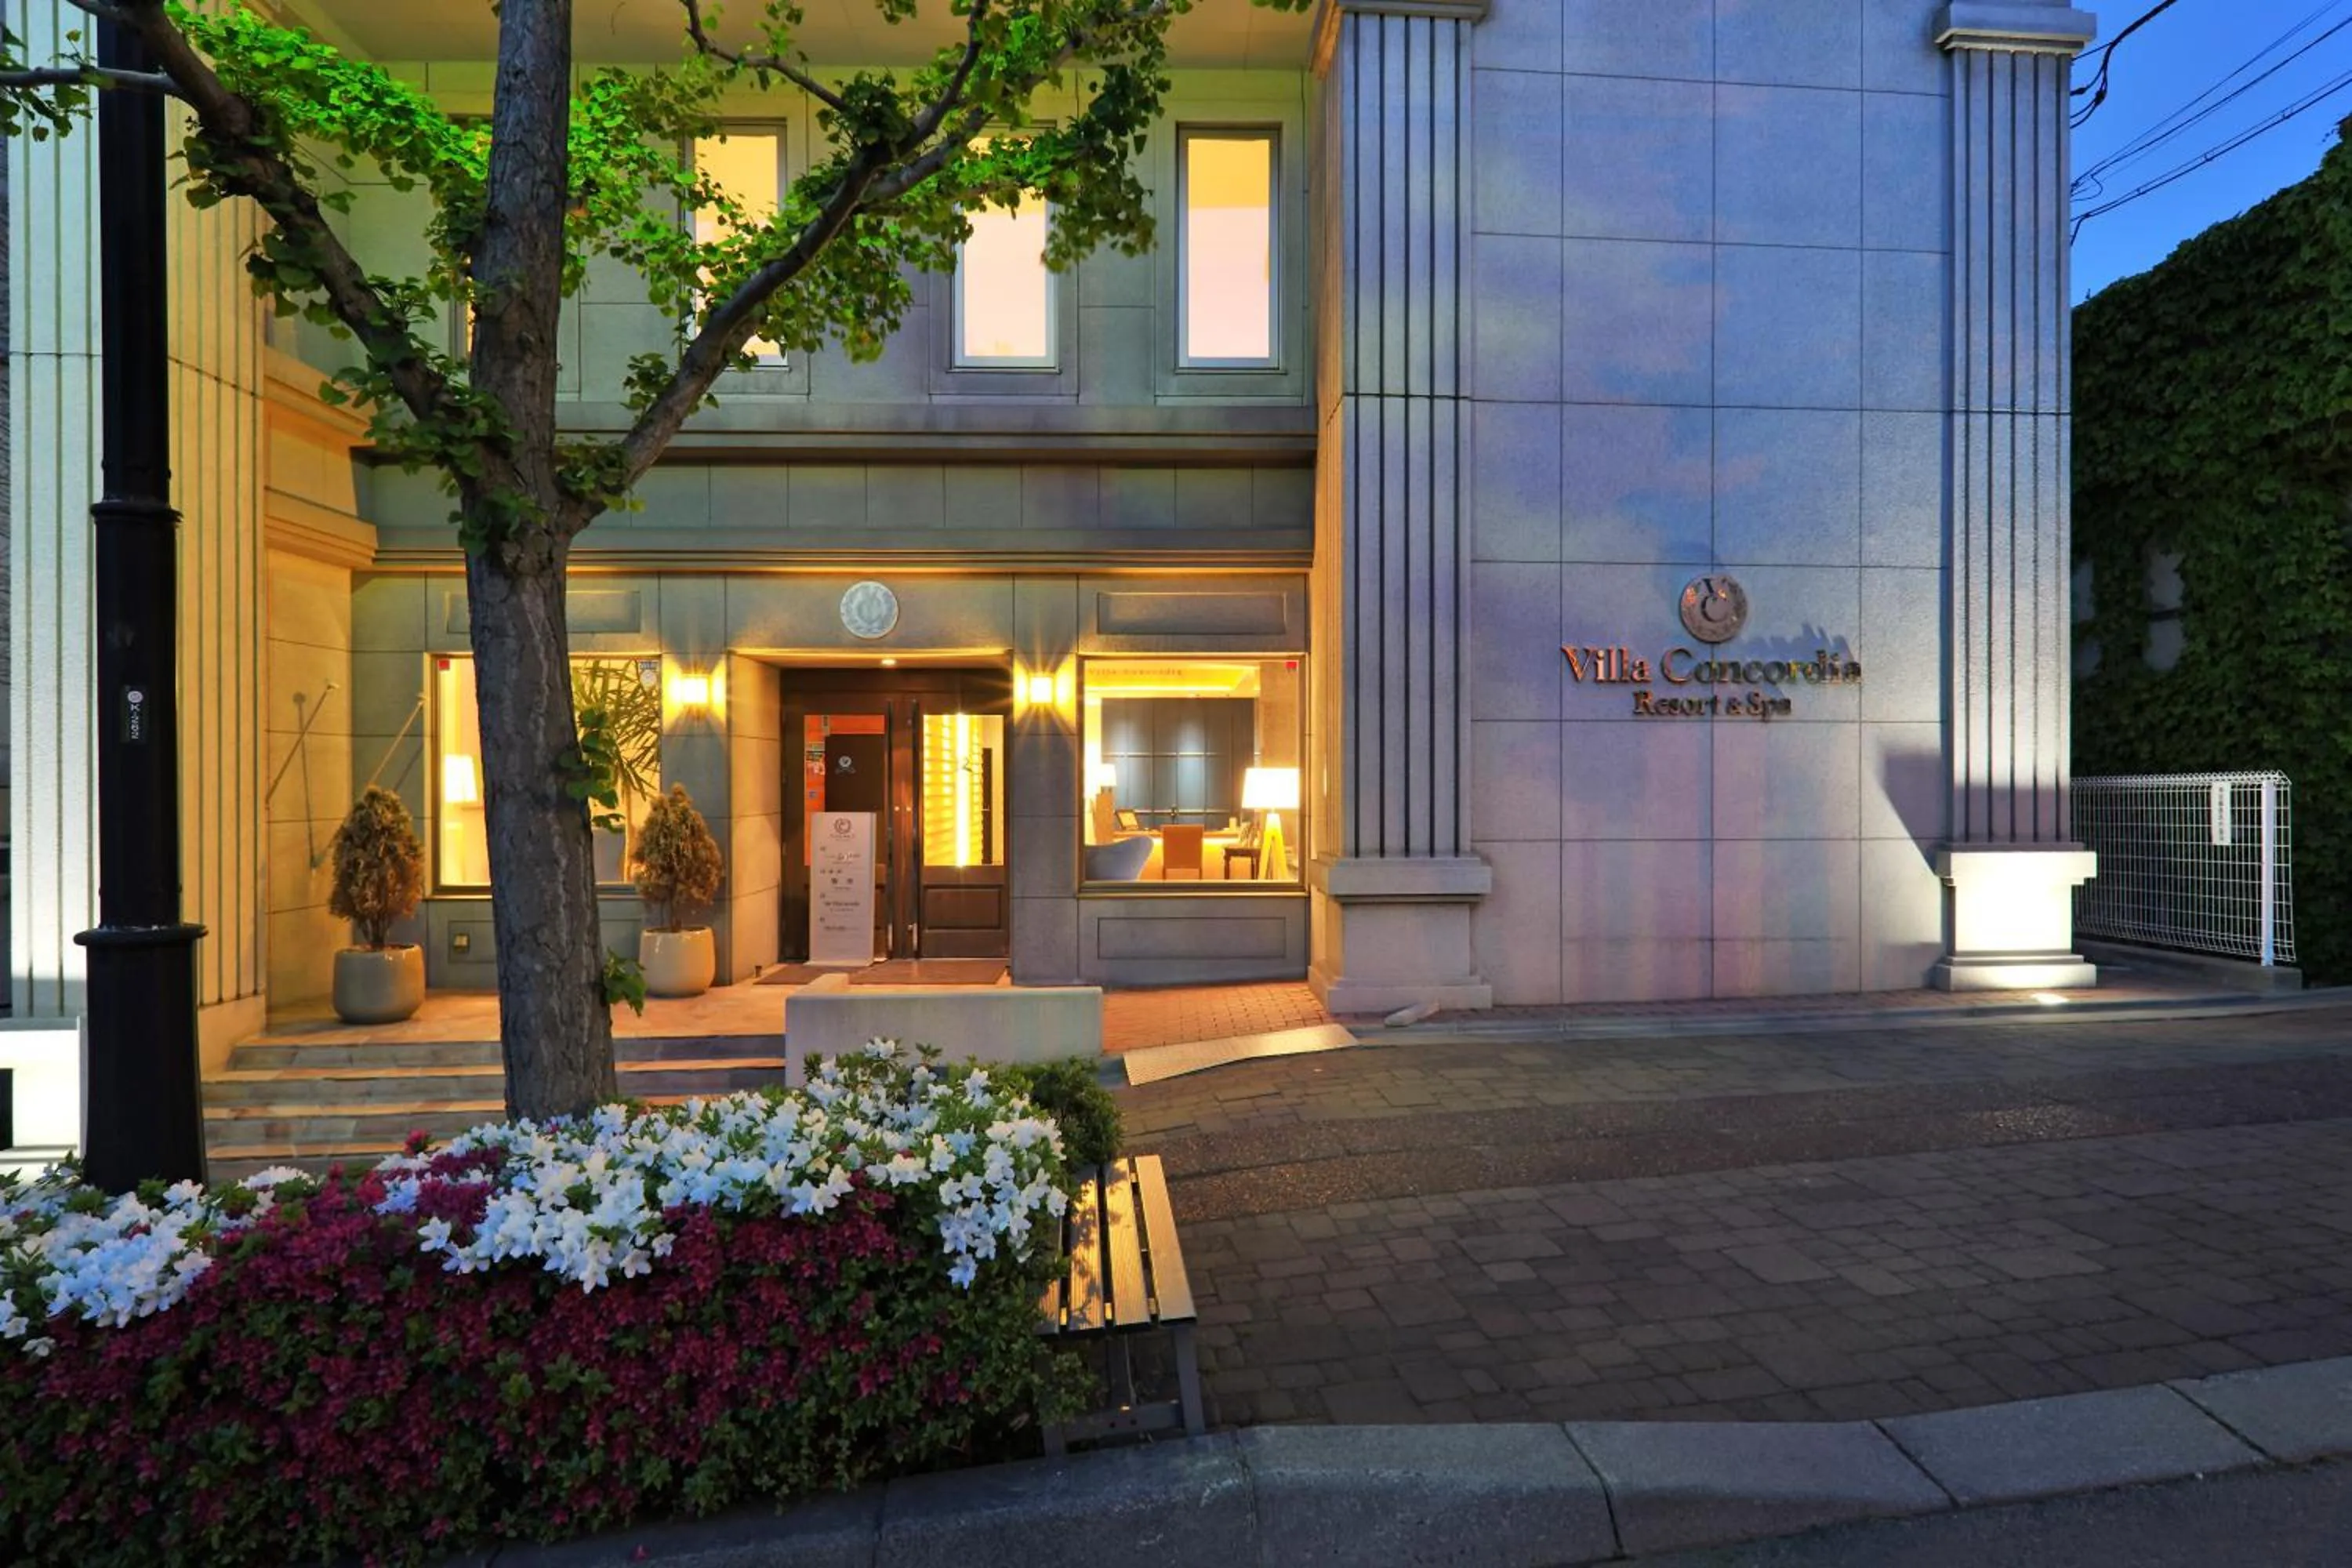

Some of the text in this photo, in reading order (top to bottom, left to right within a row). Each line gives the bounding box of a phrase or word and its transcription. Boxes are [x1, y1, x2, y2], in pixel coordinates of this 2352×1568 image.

[1560, 644, 1862, 685] Villa Concordia
[1633, 690, 1792, 723] Resort & Spa
